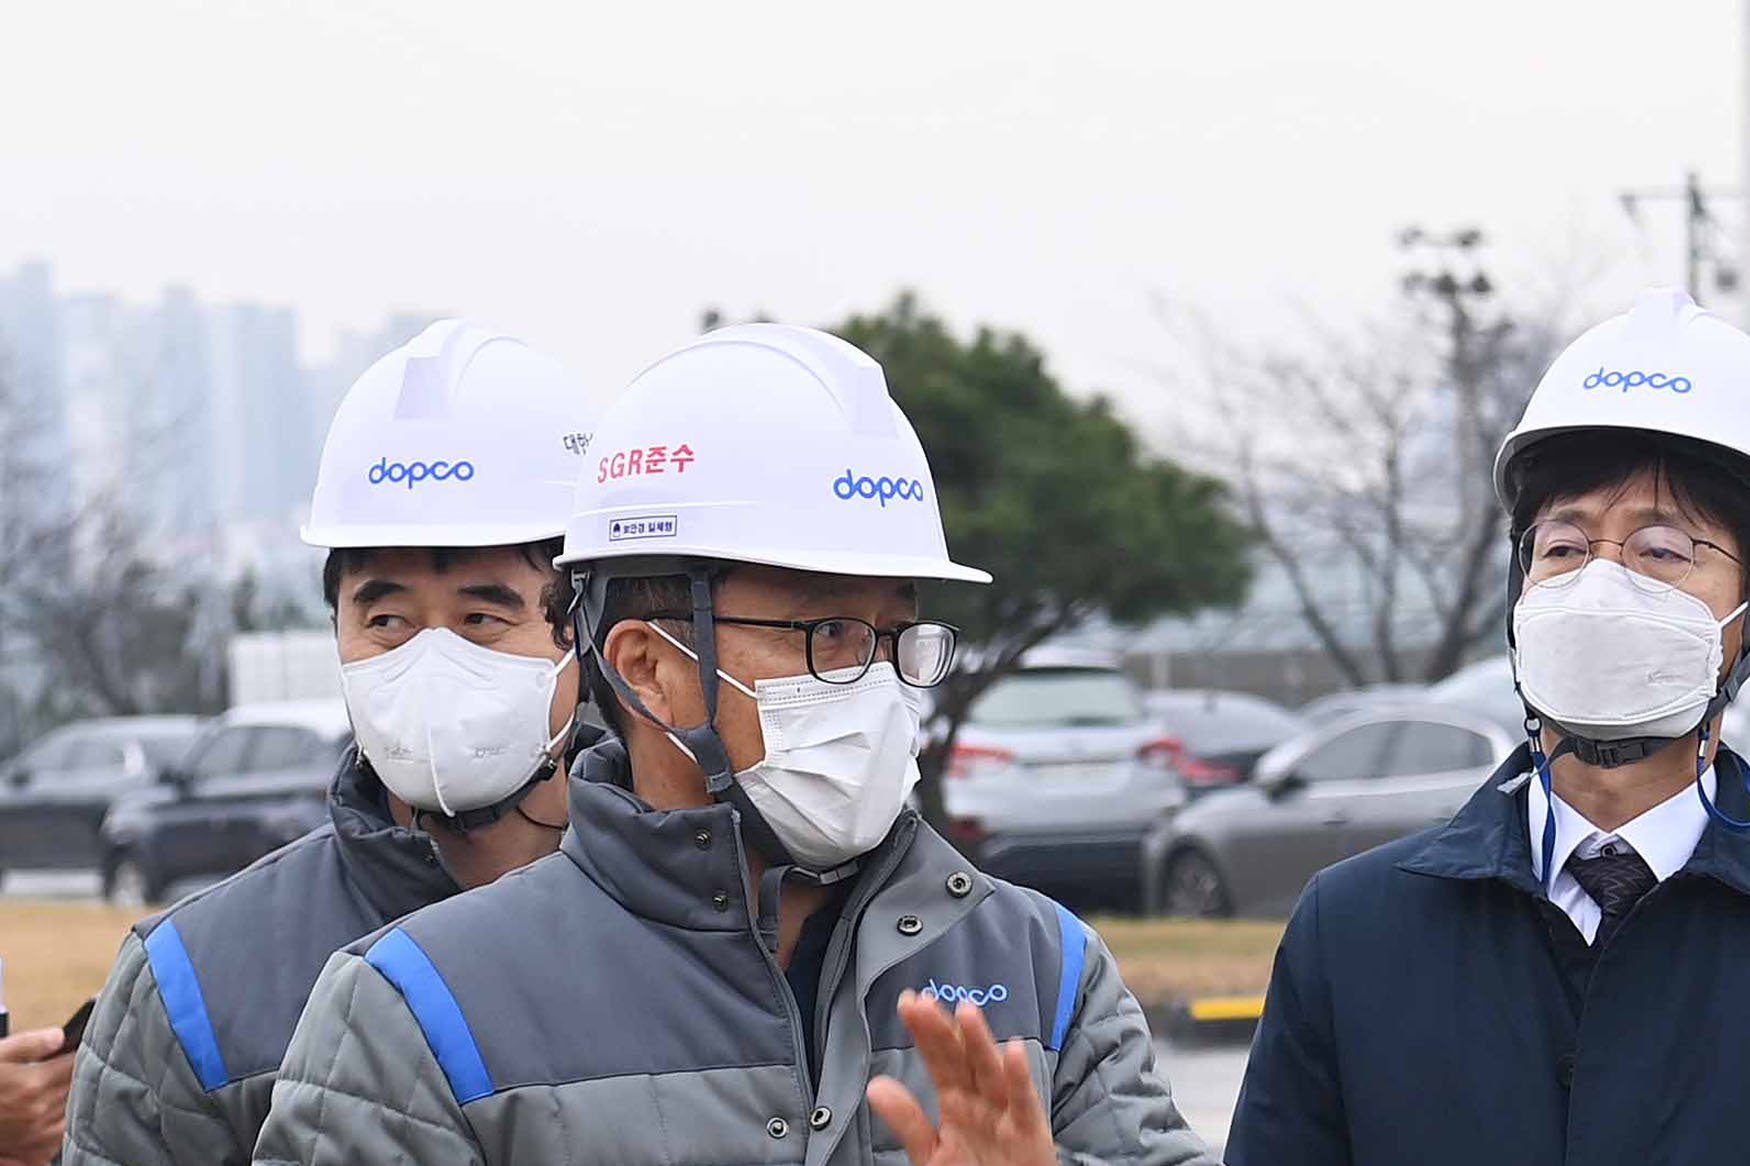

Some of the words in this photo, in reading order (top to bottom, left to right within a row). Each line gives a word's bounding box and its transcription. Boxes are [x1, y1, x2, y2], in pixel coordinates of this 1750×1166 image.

[1583, 367, 1692, 394] dopco
[368, 457, 474, 490] dopco
[597, 442, 696, 484] SGR준수
[833, 469, 924, 508] dopco
